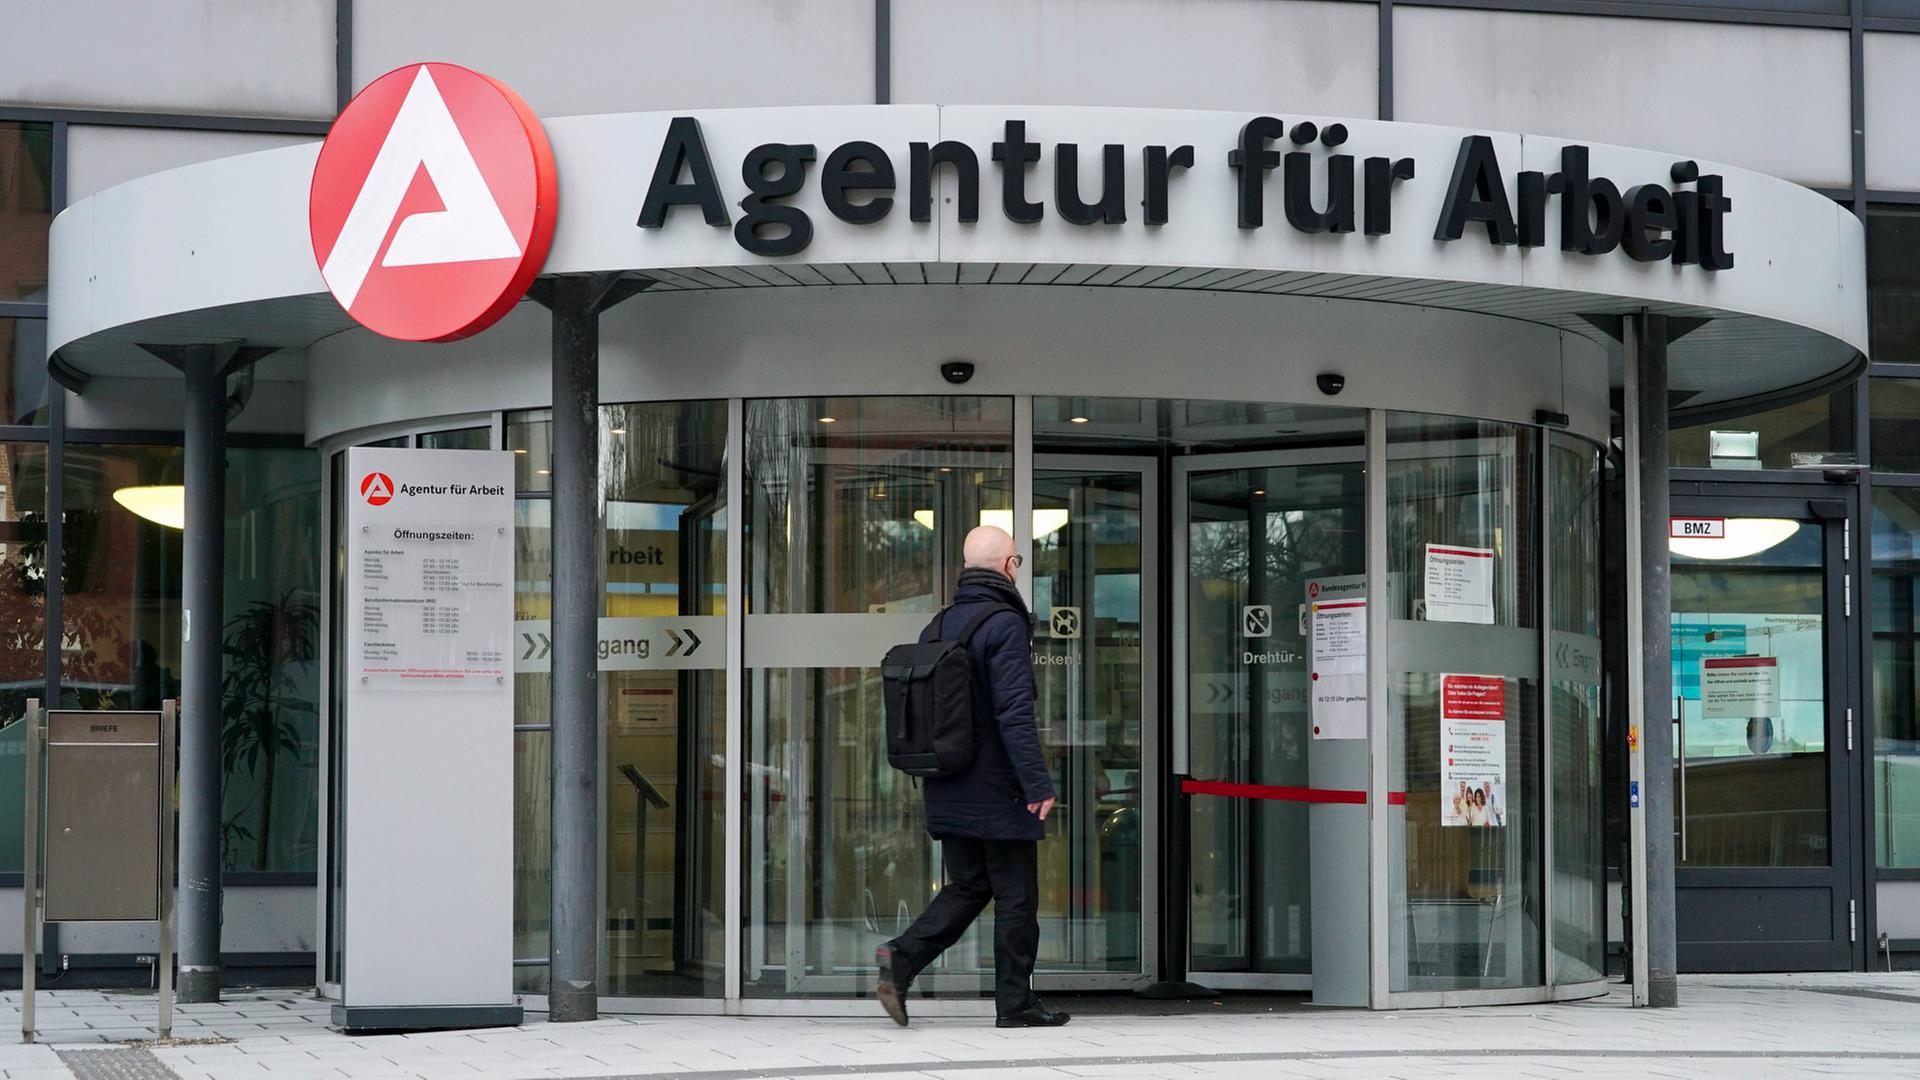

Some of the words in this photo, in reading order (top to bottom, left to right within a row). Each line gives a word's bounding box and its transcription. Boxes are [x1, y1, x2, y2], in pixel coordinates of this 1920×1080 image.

[637, 117, 1194, 256] Agentur
[1228, 116, 1414, 235] für
[1433, 135, 1734, 271] Arbeit
[400, 484, 447, 496] Agentur
[450, 484, 466, 495] für
[470, 484, 504, 496] Arbeit
[1684, 522, 1711, 534] BMZ
[394, 528, 474, 542] Öffnungszeiten:
[607, 546, 664, 565] rbeit
[1322, 584, 1359, 592] Bundesagentur
[598, 639, 650, 659] gang
[1244, 652, 1294, 664] Drehtür
